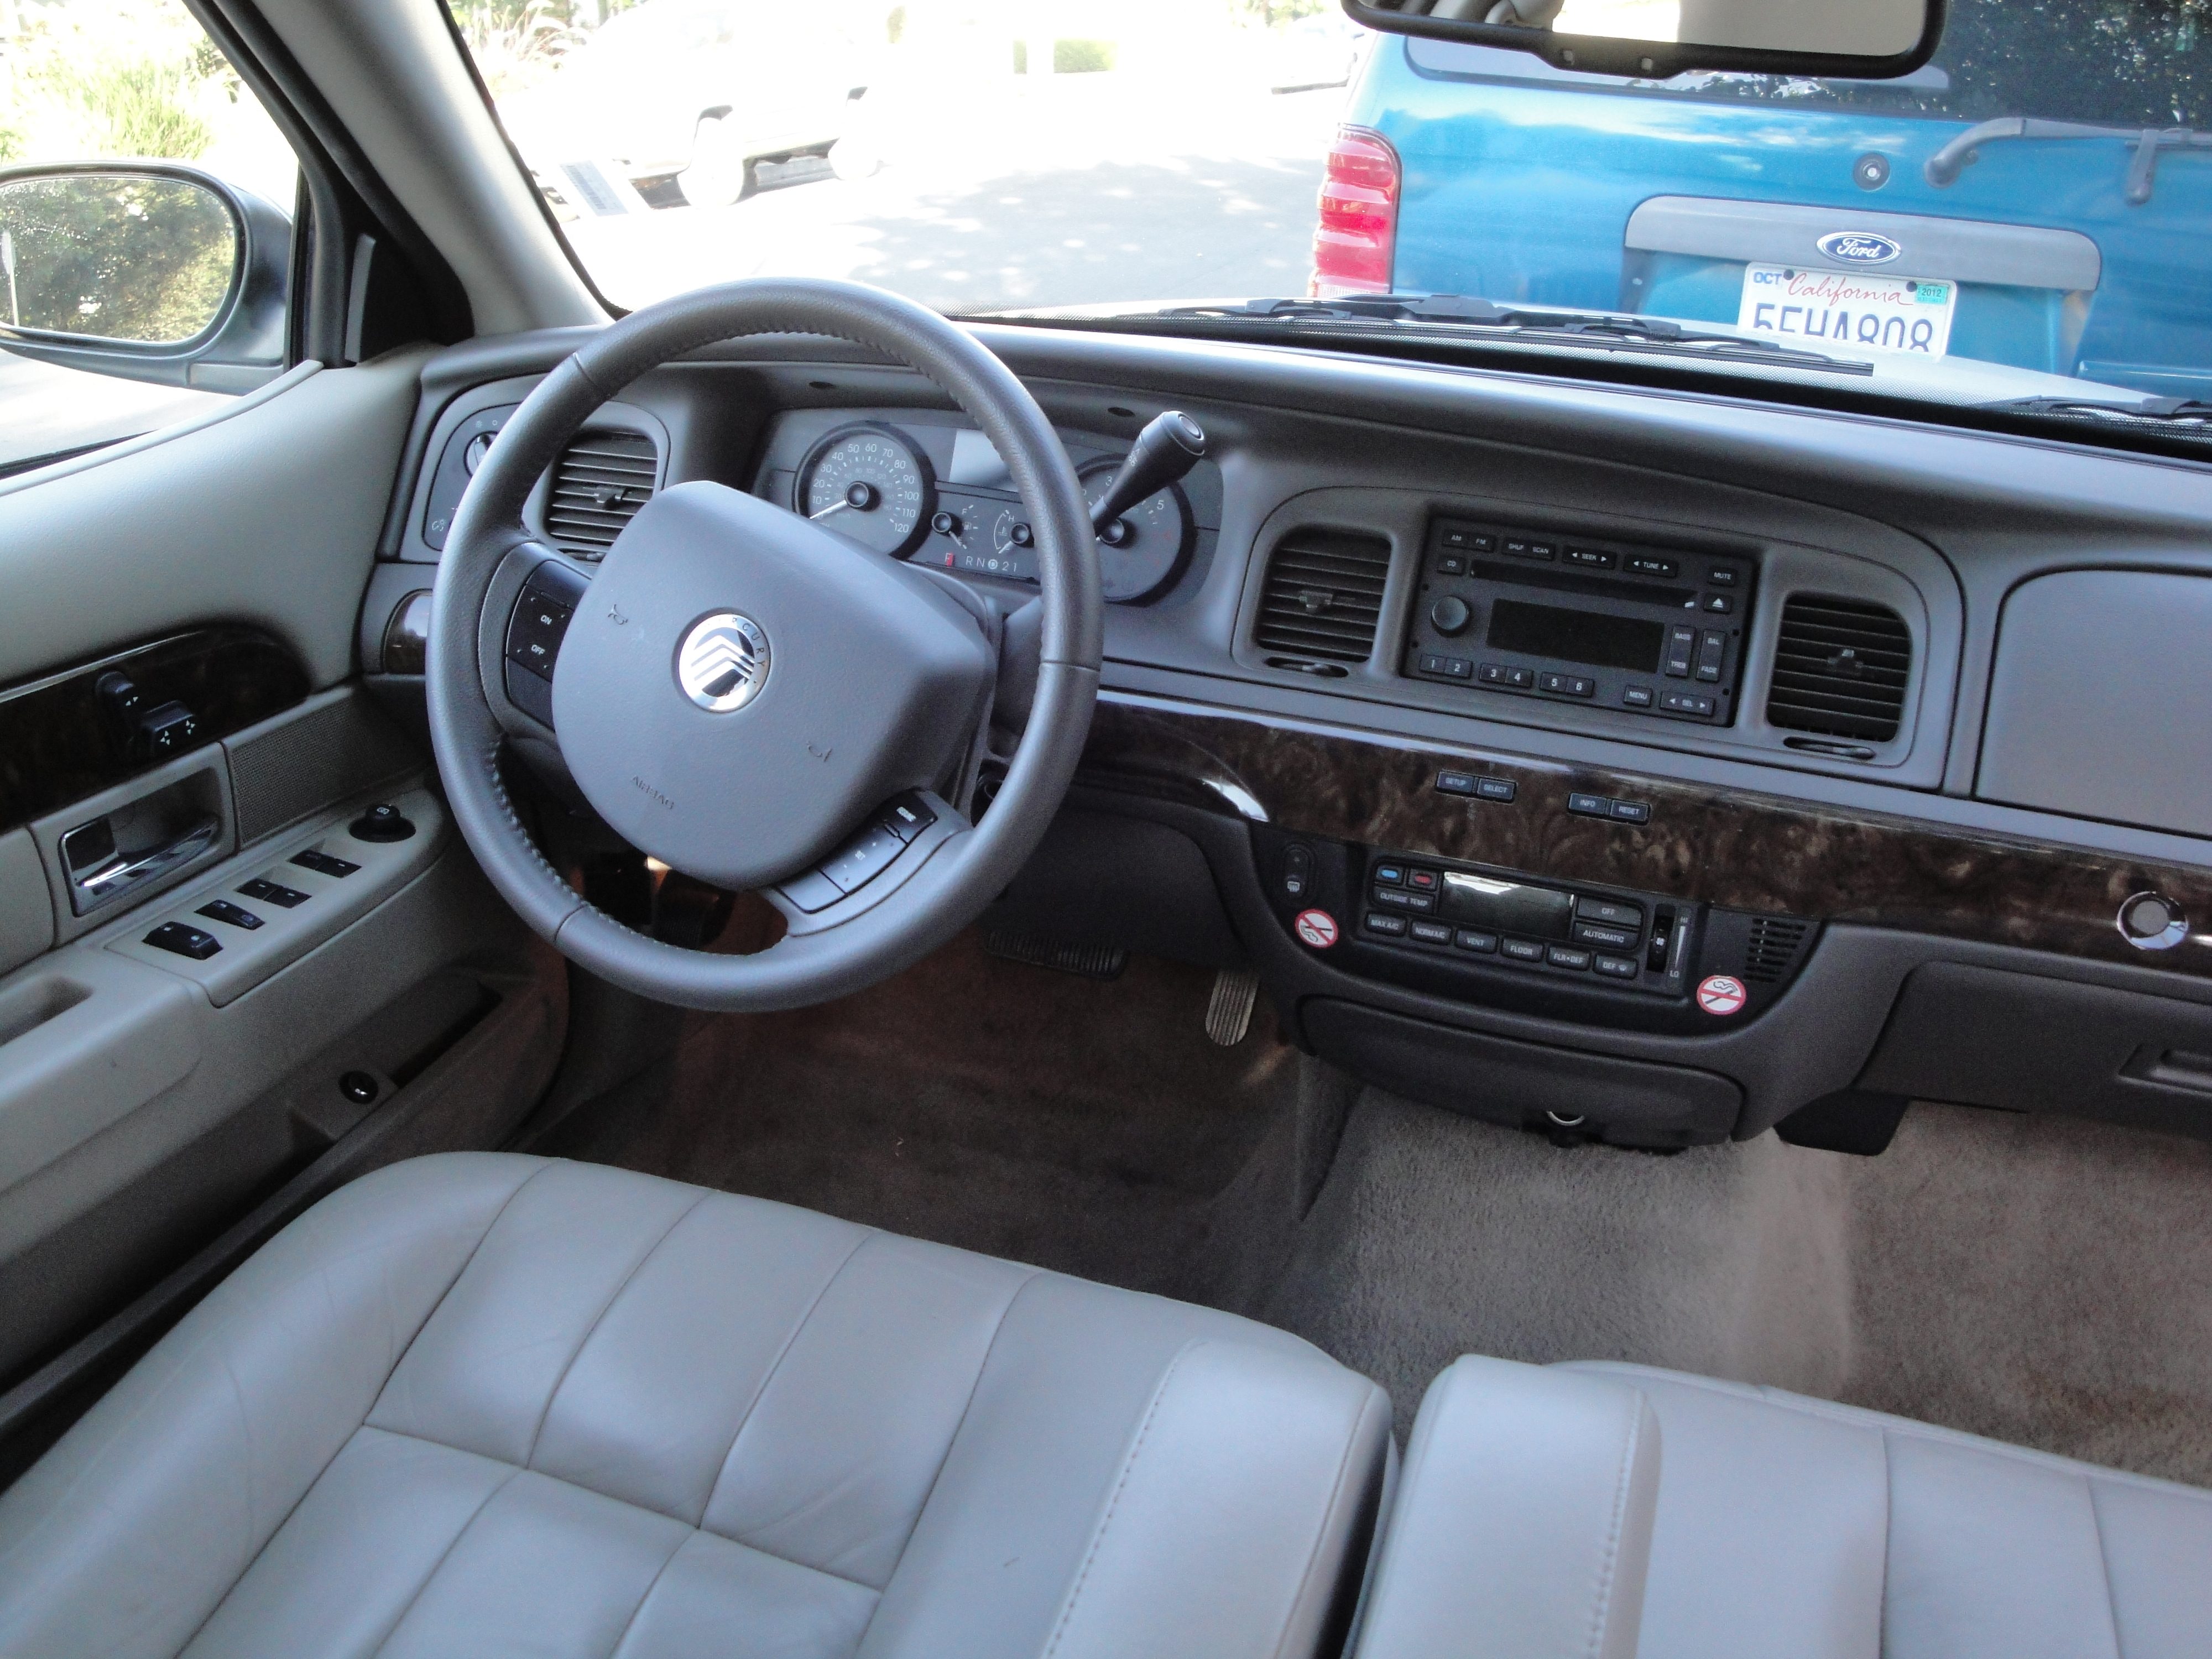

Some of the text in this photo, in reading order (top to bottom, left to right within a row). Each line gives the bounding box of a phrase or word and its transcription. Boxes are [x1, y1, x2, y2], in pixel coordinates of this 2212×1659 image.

[1837, 237, 1881, 259] Ford
[1753, 272, 1782, 286] OCT
[1787, 272, 1913, 306] California
[1921, 288, 1942, 298] 2012
[848, 444, 859, 453] 50
[865, 444, 877, 452] 60
[883, 448, 893, 457] 70
[832, 452, 843, 461] 40
[820, 465, 832, 473] 30
[894, 460, 906, 469] 80
[813, 479, 825, 488] 20
[903, 475, 915, 484] 90
[1106, 476, 1113, 486] 3
[812, 496, 822, 504] 10
[904, 492, 919, 500] 100
[1157, 500, 1164, 510] 5
[902, 508, 916, 518] 110
[894, 523, 909, 533] 120
[966, 556, 972, 566] R
[977, 557, 985, 567] N
[1002, 561, 1009, 571] 2
[1014, 562, 1017, 572] 1
[1643, 561, 1659, 570] TUNE
[1714, 571, 1731, 580] MUTE
[540, 614, 552, 625] ON
[531, 644, 545, 655] OFF
[1431, 659, 1435, 669] 1
[1454, 664, 1460, 672] 2
[1491, 669, 1496, 677] 3
[1701, 665, 1717, 674] FADE
[1514, 673, 1521, 682] 4
[1576, 682, 1582, 691] 6
[1629, 691, 1647, 700] MENU
[1445, 777, 1466, 786] SETUP
[1483, 784, 1507, 794] SELECT
[1580, 799, 1595, 808] INFO
[1619, 806, 1639, 815] RESET
[1380, 893, 1428, 906] OUTSIDE TEMP
[1371, 919, 1385, 927] MAX
[1583, 929, 1624, 943] AUTOMATIC
[1467, 938, 1484, 946] VENT
[1510, 946, 1533, 956] FLOOR
